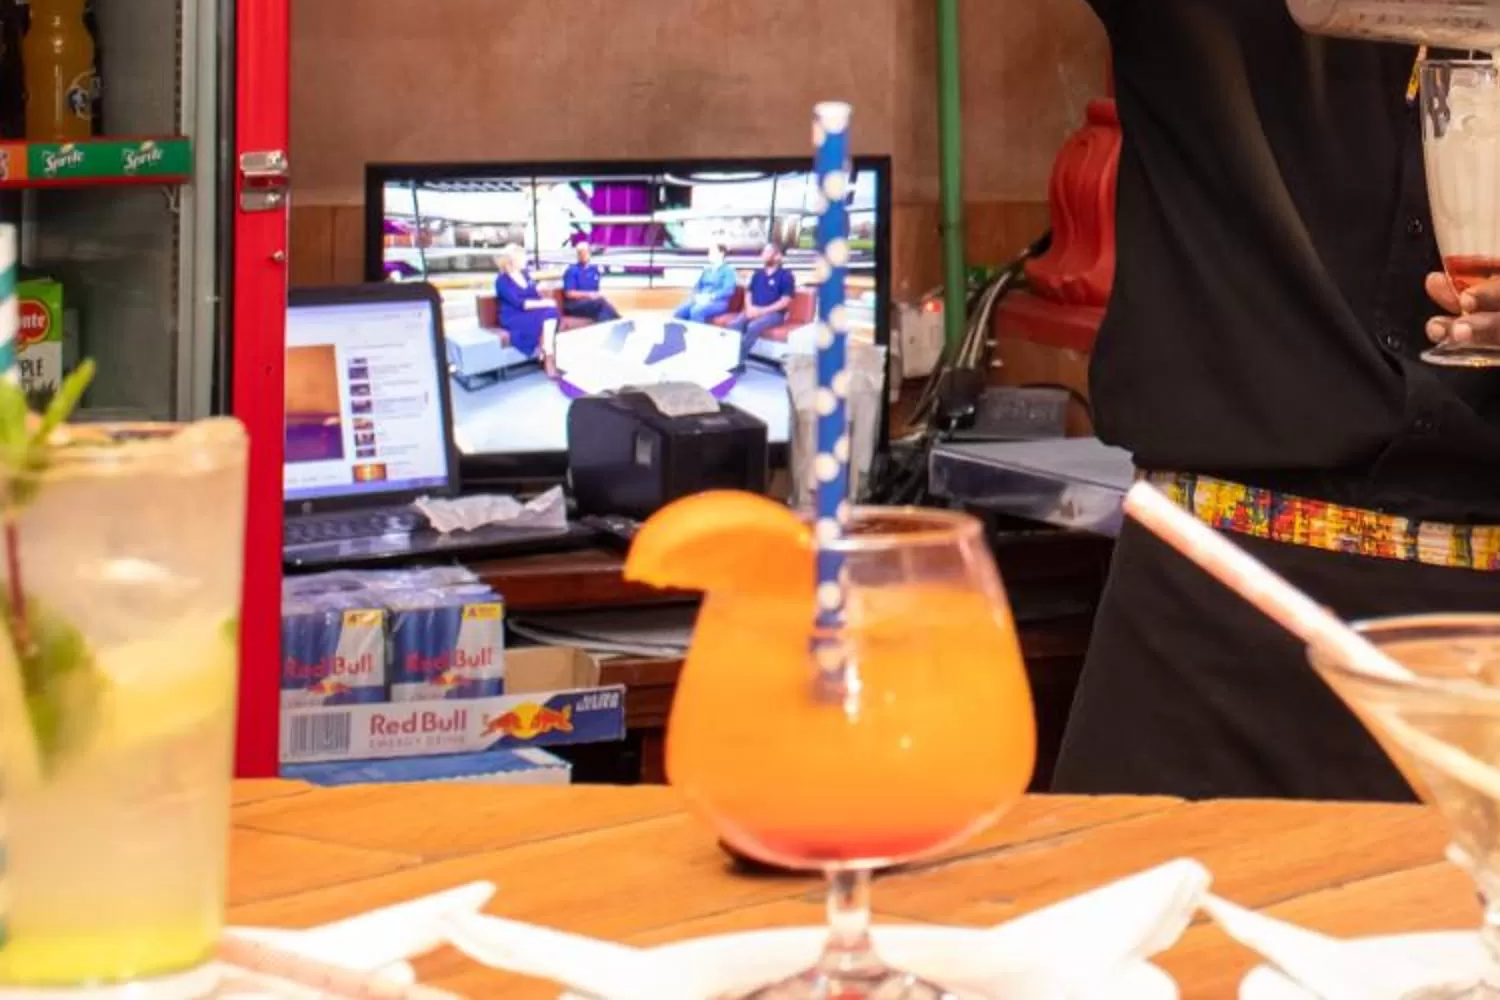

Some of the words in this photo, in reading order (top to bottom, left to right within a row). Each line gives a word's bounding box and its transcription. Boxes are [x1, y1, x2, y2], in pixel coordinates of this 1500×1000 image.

[42, 150, 84, 176] Sprite
[122, 148, 163, 175] Sprite
[286, 657, 330, 678] Red
[334, 654, 374, 674] Bull
[406, 653, 450, 672] Red
[455, 648, 493, 667] Bull
[370, 711, 417, 735] Red
[421, 709, 467, 733] Bull
